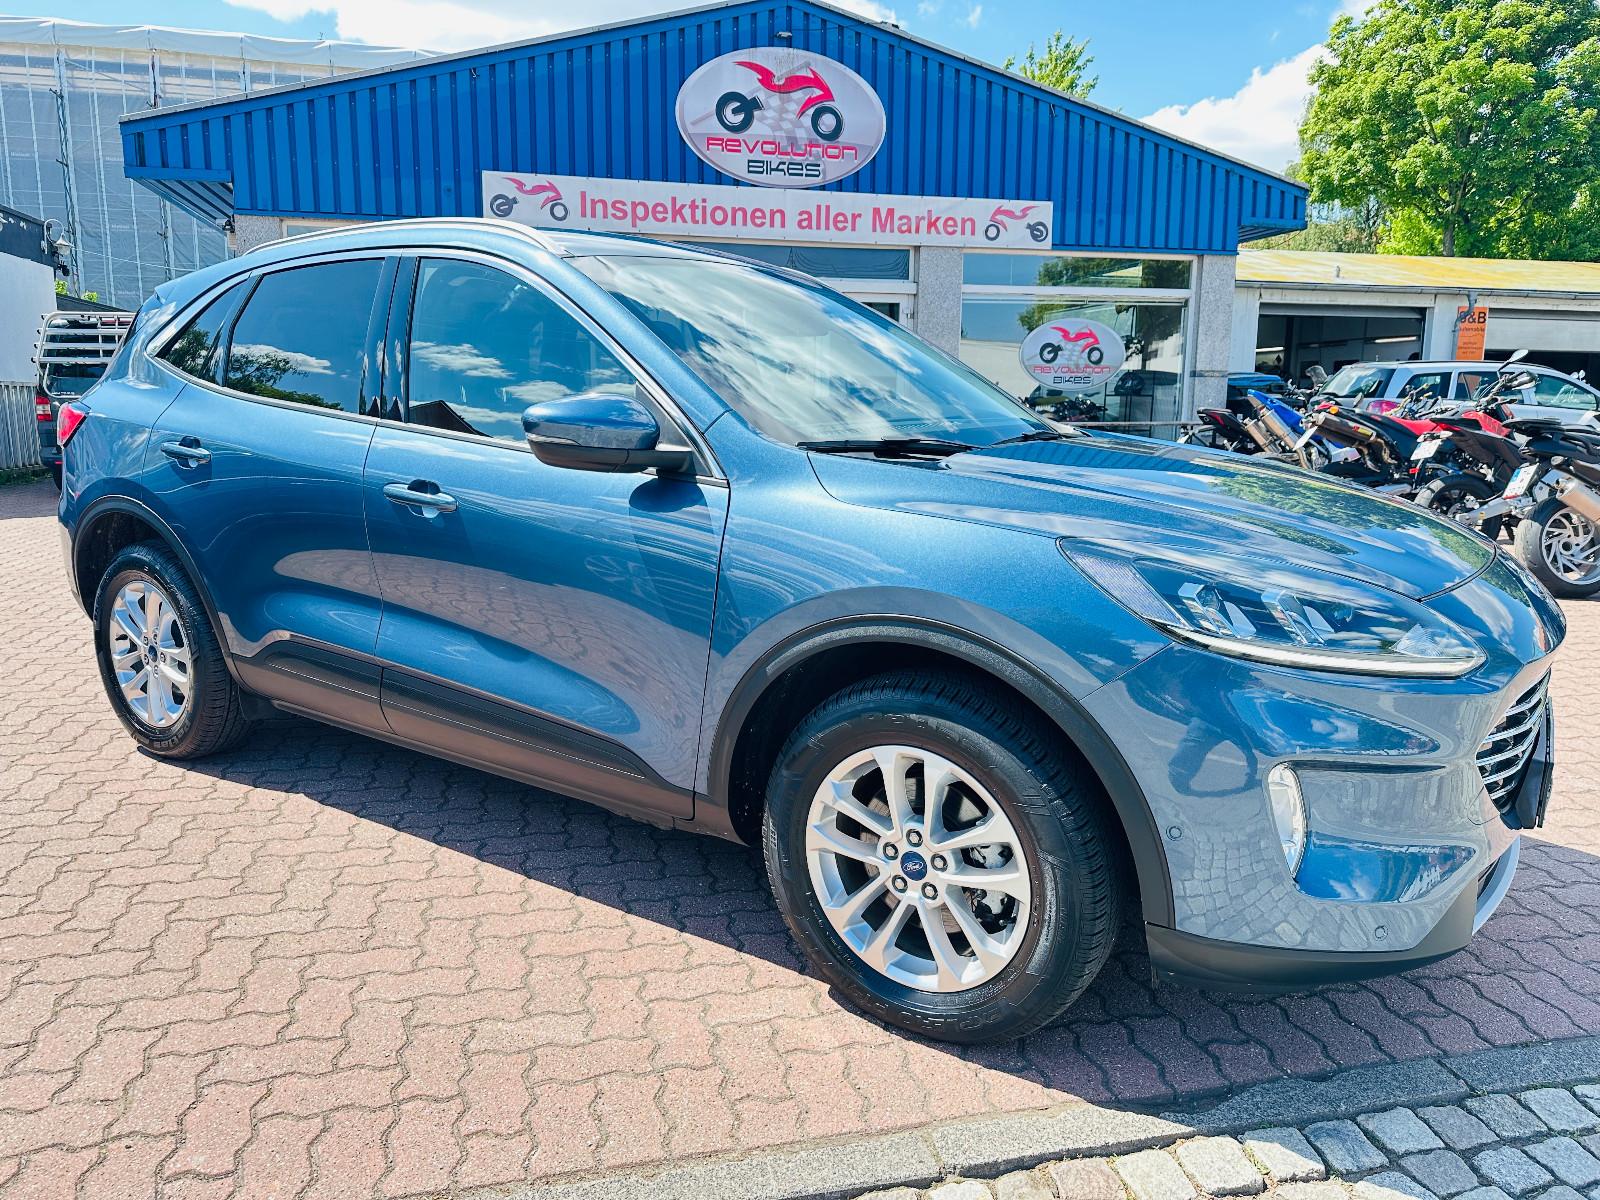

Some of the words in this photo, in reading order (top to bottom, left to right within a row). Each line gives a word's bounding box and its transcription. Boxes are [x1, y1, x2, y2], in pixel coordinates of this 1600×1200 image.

[706, 136, 858, 160] REVOLUTION
[747, 159, 821, 178] BIKES
[579, 190, 786, 229] Inspektionen
[796, 199, 862, 232] aller
[871, 206, 977, 236] Marken
[1033, 365, 1111, 375] REVOLUTION
[1053, 376, 1092, 385] BIKES
